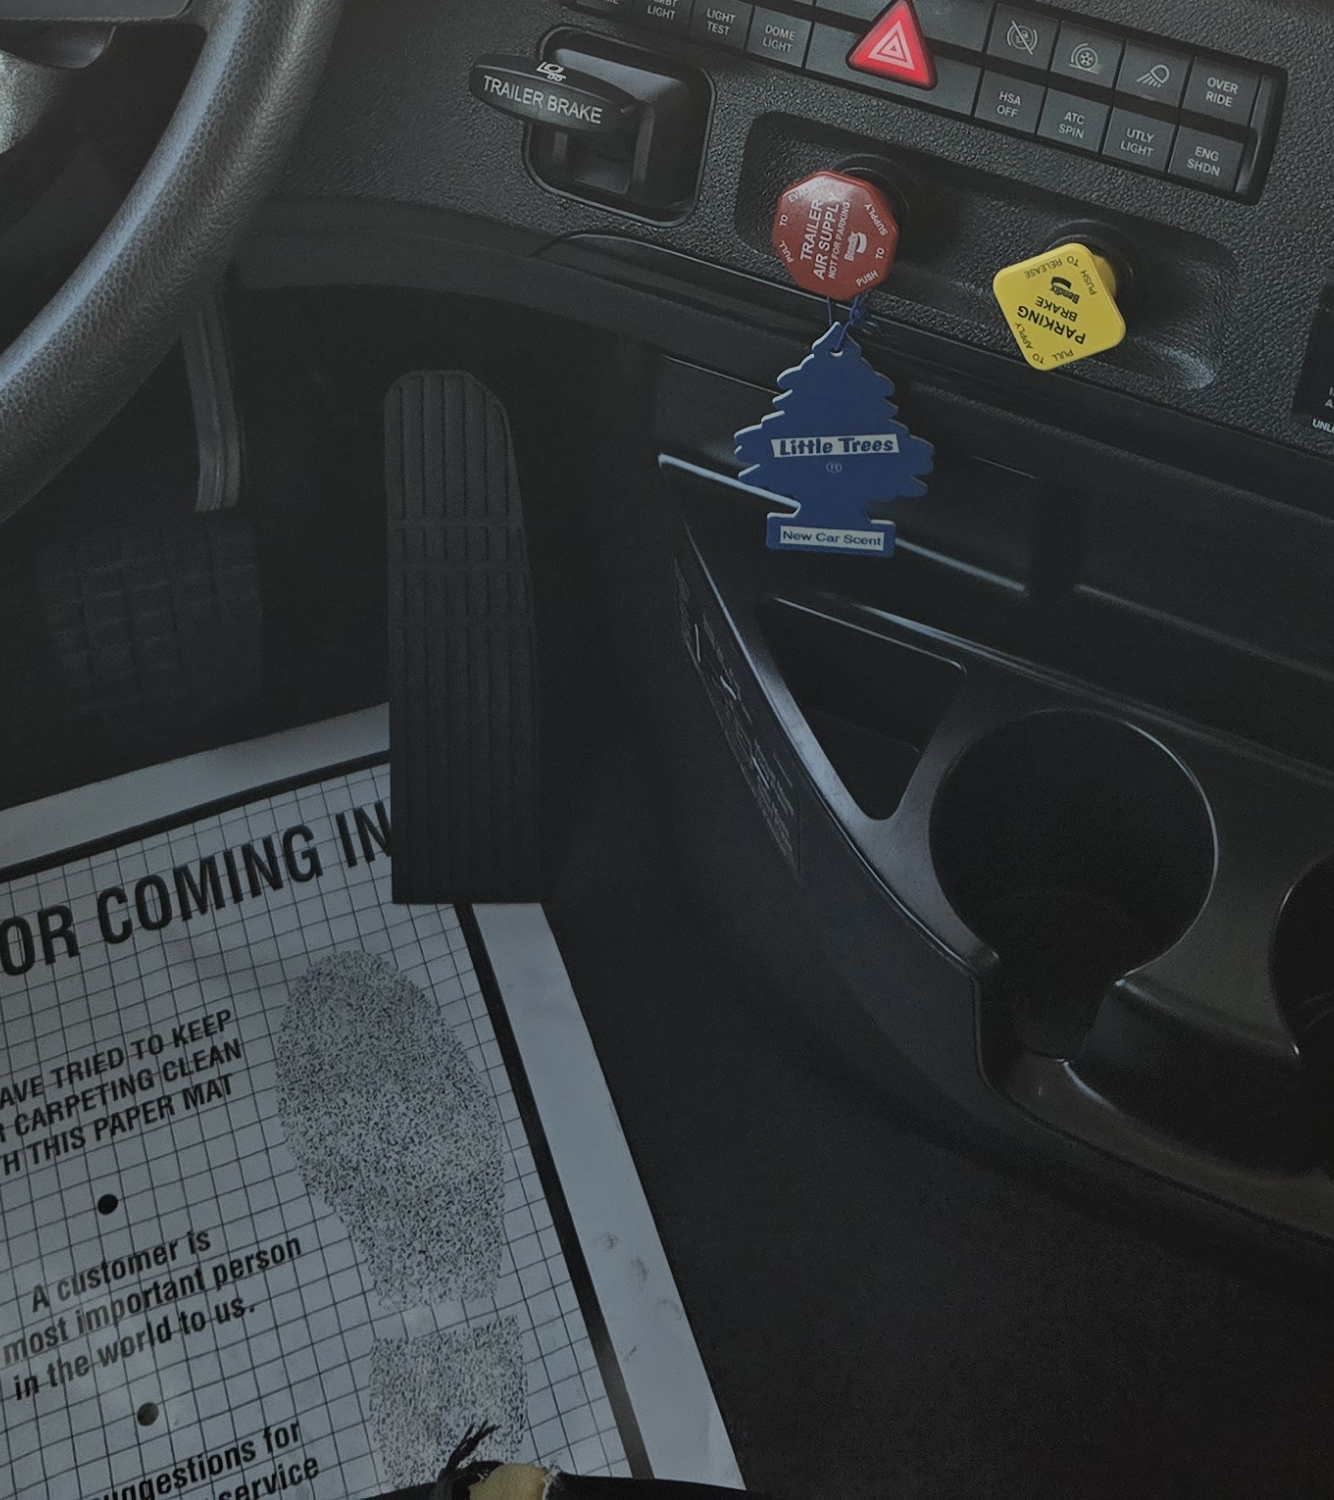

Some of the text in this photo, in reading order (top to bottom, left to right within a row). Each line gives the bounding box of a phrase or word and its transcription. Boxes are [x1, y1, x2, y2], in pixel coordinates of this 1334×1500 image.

[647, 4, 676, 21] LIGHT
[706, 8, 736, 25] LIGHT
[707, 21, 731, 36] TEST
[765, 24, 796, 41] DOME
[762, 36, 792, 53] LIGHT
[1206, 76, 1239, 94] OVER
[483, 75, 602, 125] TRAILER BRAKE
[998, 90, 1022, 107] HSA
[1205, 90, 1233, 108] RIDE
[996, 103, 1019, 119] OFF
[1064, 111, 1086, 126] ATC
[1058, 122, 1085, 139] SPIN
[1126, 127, 1155, 144] UTLY
[1120, 140, 1154, 158] LIGHT
[1194, 146, 1219, 162] ENG
[1187, 158, 1220, 177] SHDN
[799, 199, 824, 261] TRAILER
[844, 231, 858, 262] Bendix
[813, 254, 828, 281] AIR
[1023, 257, 1063, 280] RELEASE
[855, 270, 879, 288] PUSH
[1049, 285, 1080, 304] Bendix
[1034, 296, 1078, 322] BRAKE
[1016, 305, 1087, 345] PARKING
[1051, 348, 1074, 362] PULL
[779, 435, 894, 456] Little Trees
[782, 530, 882, 547] New Car Scent
[97, 823, 324, 945] COMING
[335, 800, 393, 869] IN
[50, 1047, 125, 1089] TRIED
[130, 1033, 165, 1060] TO
[172, 1008, 233, 1049] KEEP
[14, 1068, 156, 1136] CARPETING
[162, 1037, 244, 1083] CLEAN
[26, 1126, 87, 1166] THIS
[93, 1093, 176, 1142] PAPER
[181, 1072, 234, 1111] MAT
[31, 1229, 212, 1313] A customer is
[3, 1315, 70, 1366] most
[76, 1266, 207, 1336] important
[211, 1236, 303, 1291] person
[13, 1297, 256, 1401] in the world to us.
[263, 1421, 301, 1455] for
[219, 1456, 321, 1500] service
